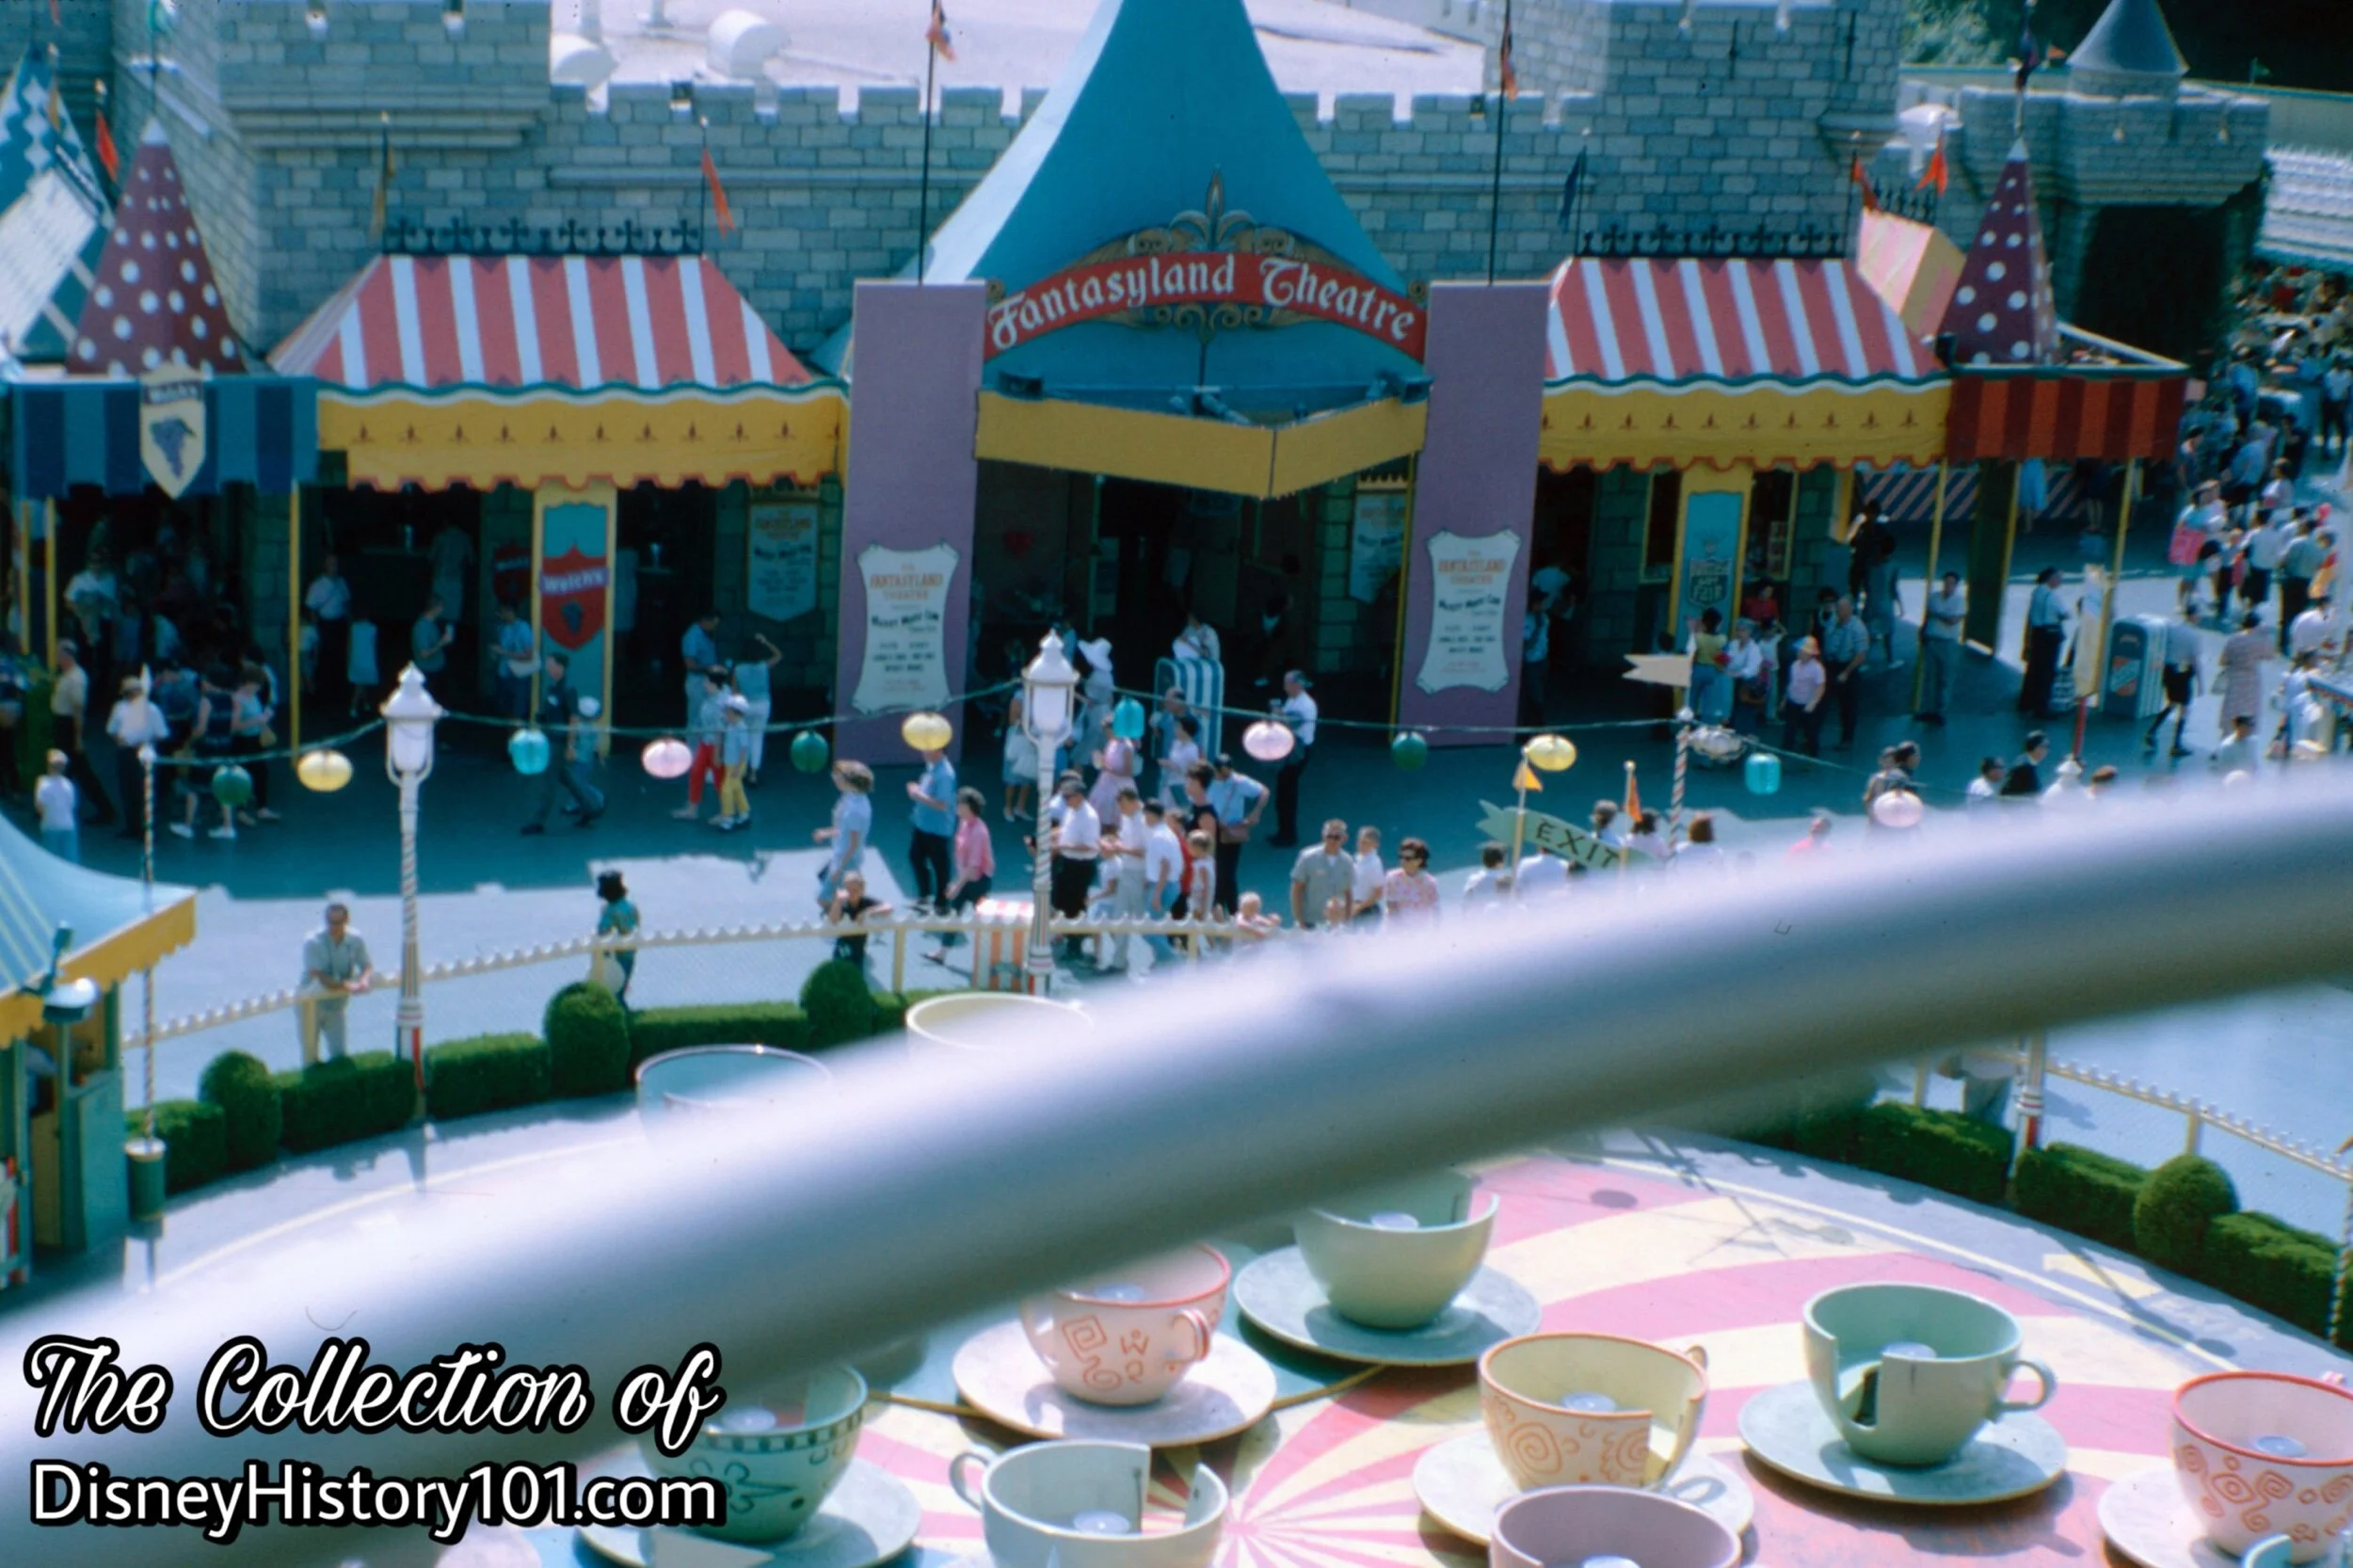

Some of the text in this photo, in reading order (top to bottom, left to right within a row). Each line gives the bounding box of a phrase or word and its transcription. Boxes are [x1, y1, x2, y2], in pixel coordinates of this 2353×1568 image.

[987, 254, 1416, 351] Fantasyland Theatre
[543, 568, 604, 593] Welch's
[1536, 817, 1620, 868] EXIT
